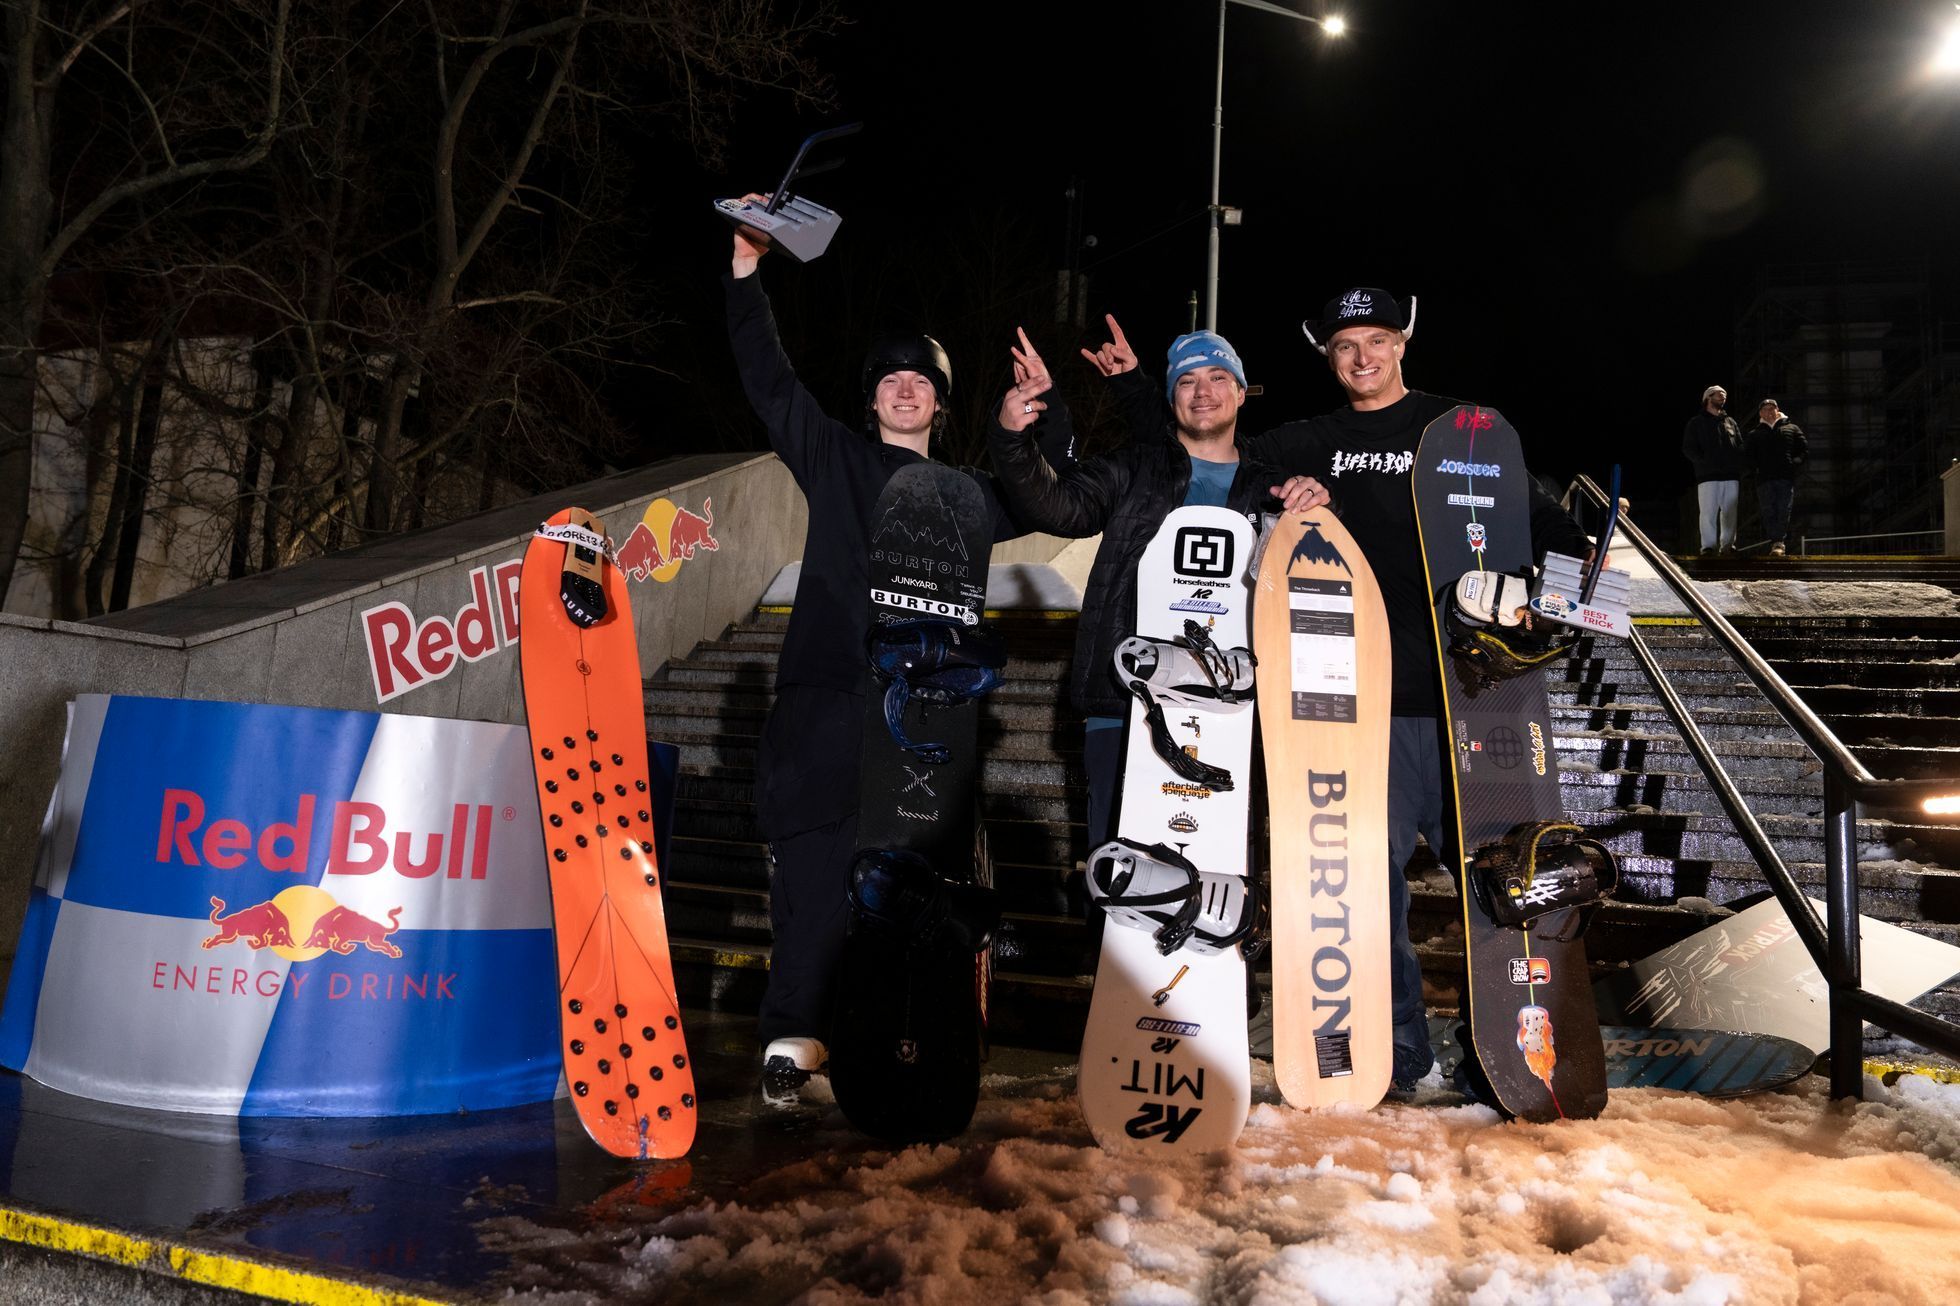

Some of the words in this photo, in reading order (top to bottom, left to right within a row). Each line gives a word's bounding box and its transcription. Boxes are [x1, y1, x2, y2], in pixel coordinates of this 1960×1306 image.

[1436, 459, 1501, 478] LOBSTER
[871, 550, 969, 578] BURTON
[1173, 577, 1231, 588] Horsefeathers
[1190, 588, 1213, 599] K2
[874, 591, 965, 617] BURTON
[1583, 609, 1608, 620] BEST
[1583, 616, 1614, 630] TRICK
[366, 570, 496, 697] Red
[155, 788, 317, 873] Red
[327, 800, 493, 880] Bull
[1308, 769, 1352, 1041] BURTON
[1512, 960, 1528, 969] THE
[1512, 967, 1529, 976] CRAP
[152, 962, 310, 998] ENERGY
[328, 972, 458, 999] DRINK
[1512, 974, 1529, 982] SHOW
[1151, 1037, 1181, 1054] K2
[1603, 1037, 1713, 1057] RTON
[1125, 1103, 1203, 1144] K2
